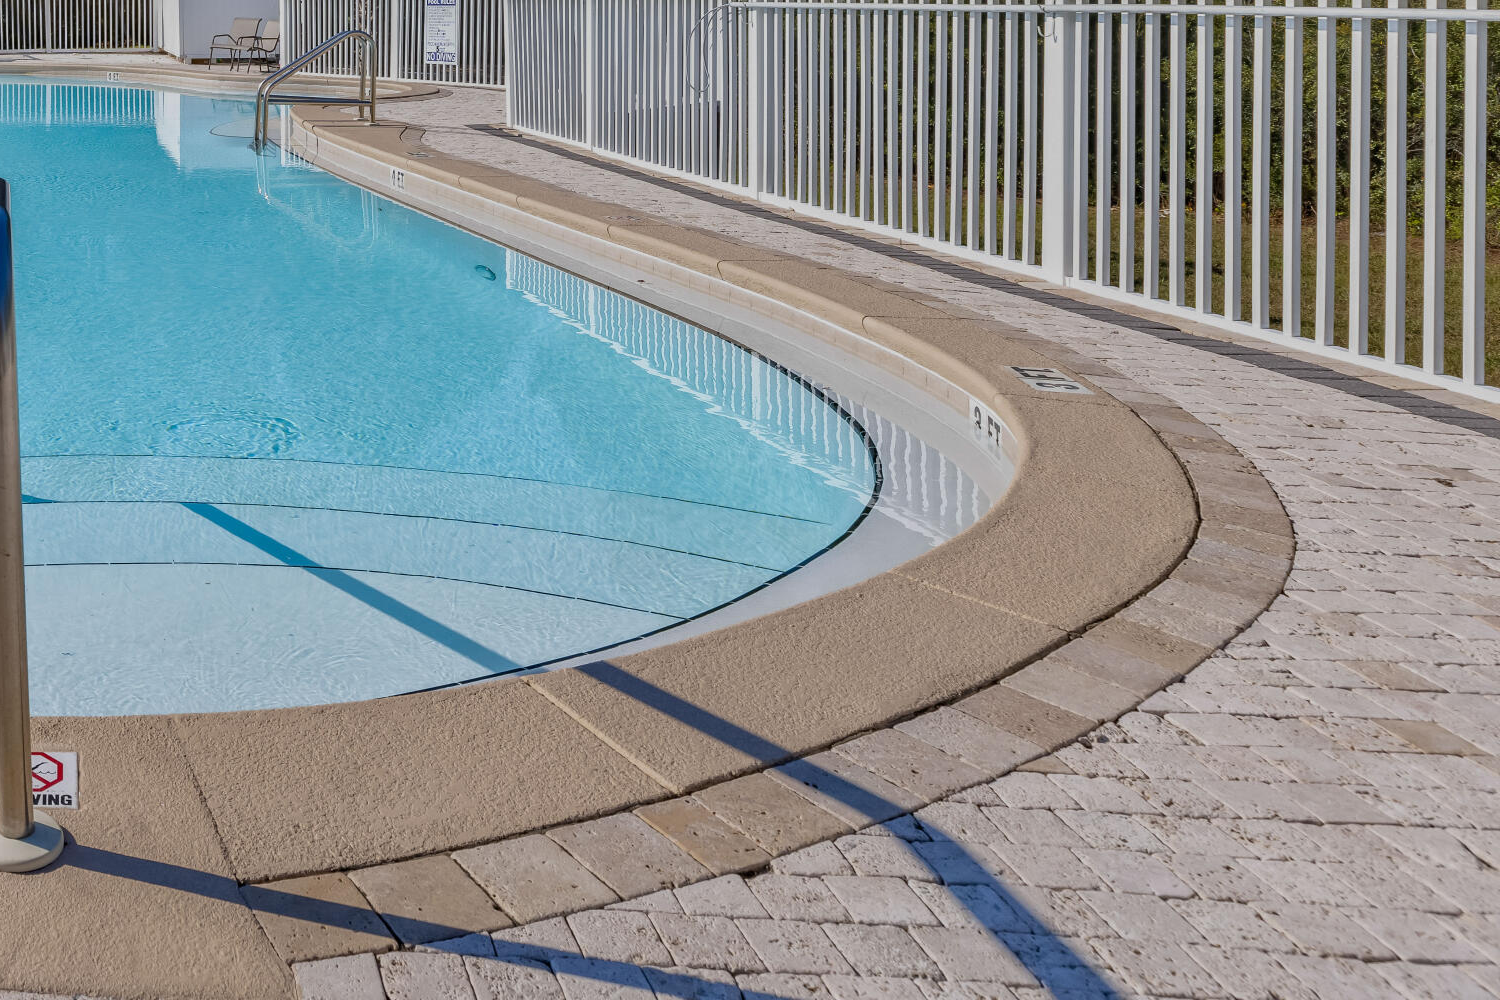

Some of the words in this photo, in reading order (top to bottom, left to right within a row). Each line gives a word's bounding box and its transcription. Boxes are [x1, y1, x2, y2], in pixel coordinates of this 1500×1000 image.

[426, 52, 435, 61] NO
[436, 52, 456, 62] DIVING
[1010, 366, 1066, 380] FT
[1035, 382, 1080, 390] 3
[32, 794, 73, 806] VING
